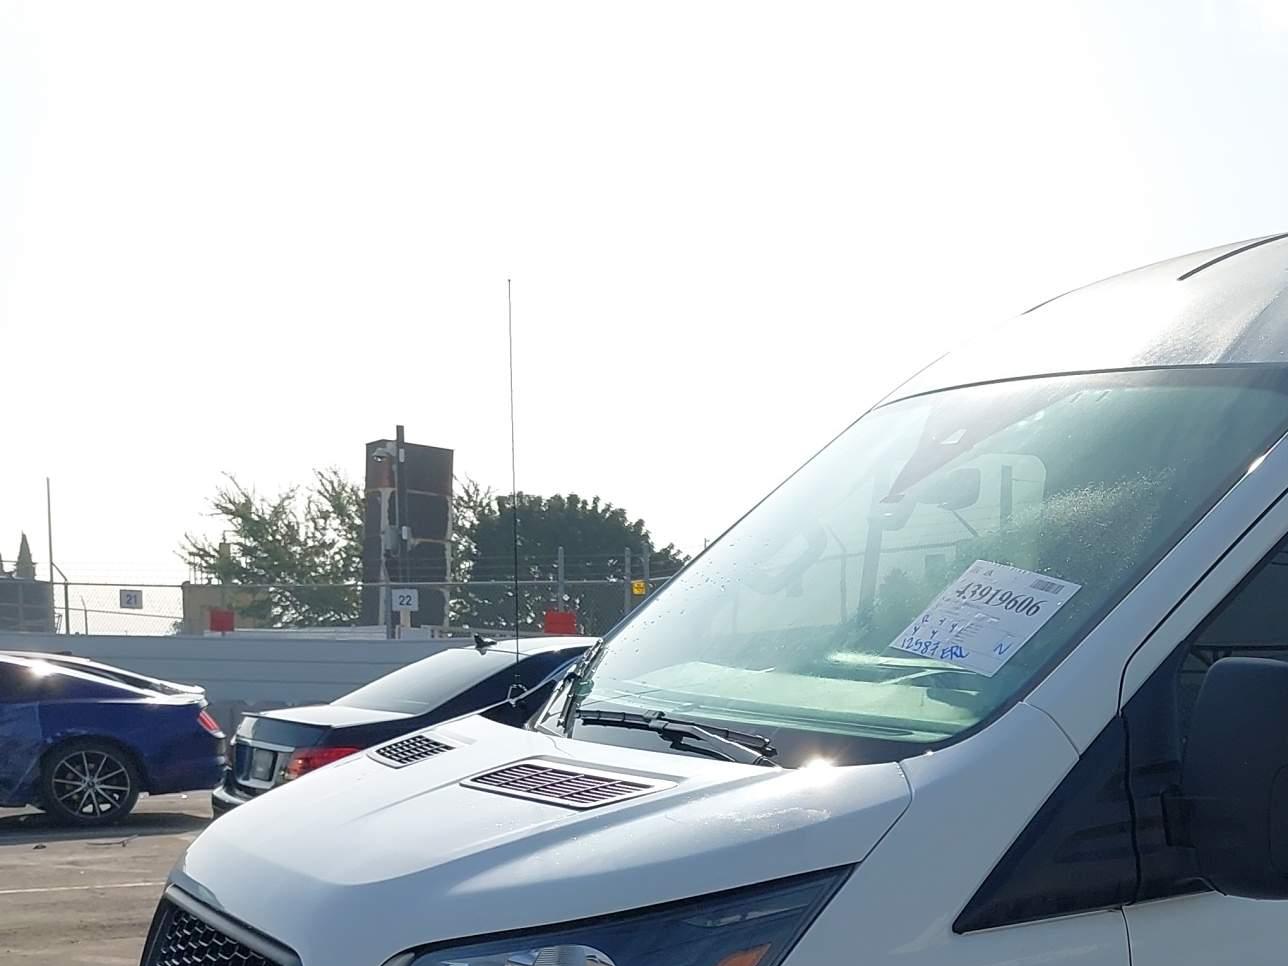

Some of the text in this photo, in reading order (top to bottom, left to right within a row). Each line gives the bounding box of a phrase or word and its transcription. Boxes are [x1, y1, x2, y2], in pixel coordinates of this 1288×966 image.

[125, 593, 138, 605] 21
[398, 595, 412, 606] 22
[956, 582, 1047, 616] 43919606
